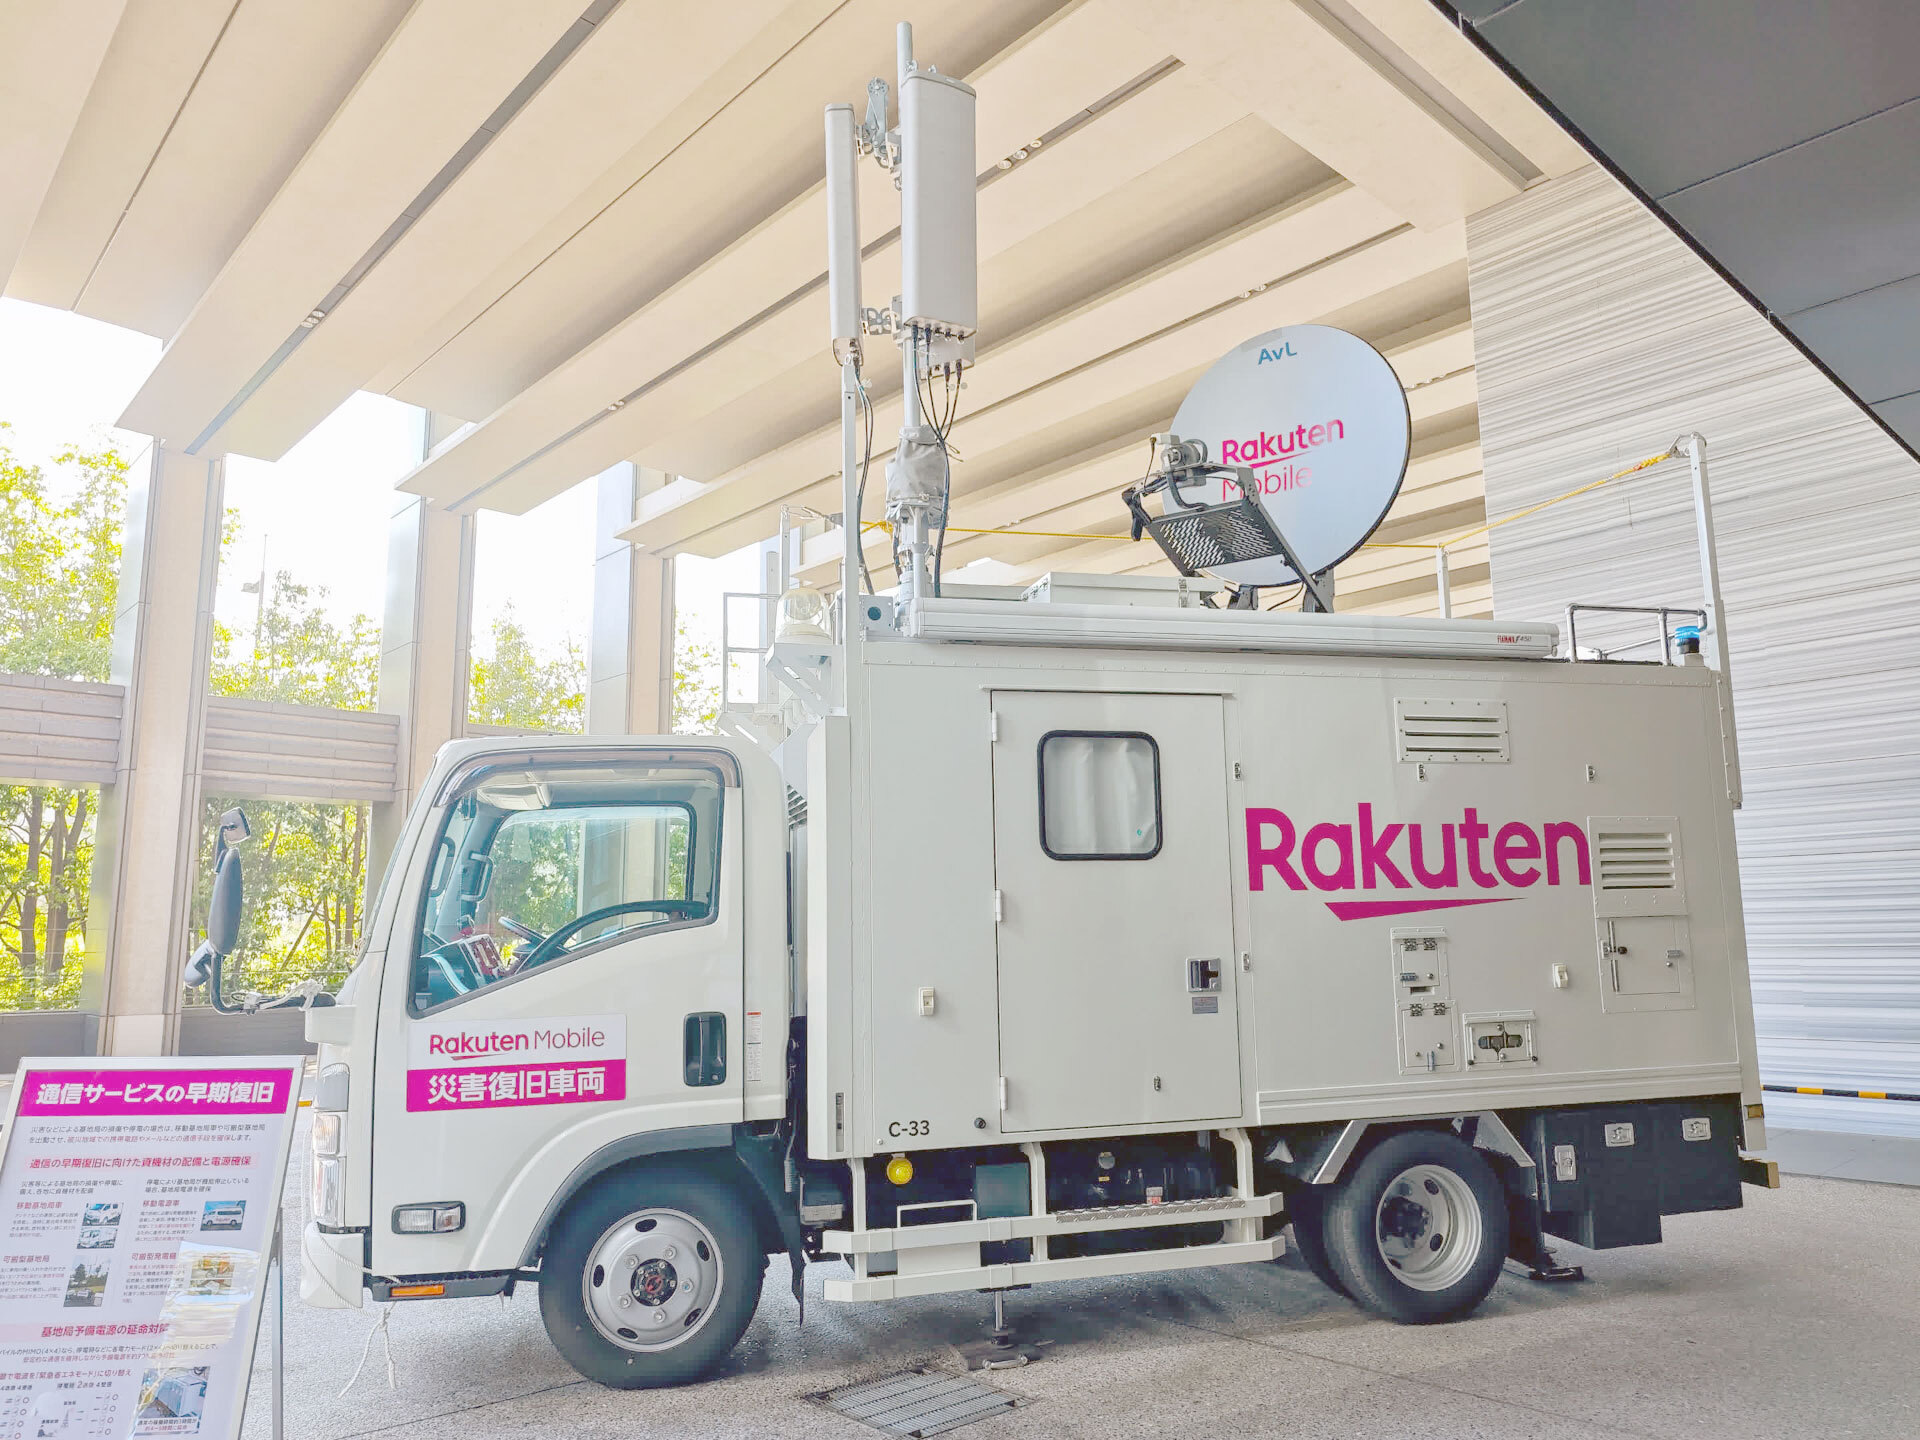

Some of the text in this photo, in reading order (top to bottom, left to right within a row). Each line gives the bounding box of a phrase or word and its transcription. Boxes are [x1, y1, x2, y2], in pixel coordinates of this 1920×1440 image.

[1258, 342, 1297, 365] AvL
[1222, 419, 1344, 465] Rakuten
[1245, 802, 1592, 892] Rakuten
[430, 1027, 605, 1055] Rakuten Mobile
[36, 1082, 275, 1105] 通信サービスの早期復旧
[428, 1066, 606, 1104] 災害復旧車両
[889, 1120, 930, 1137] C-33
